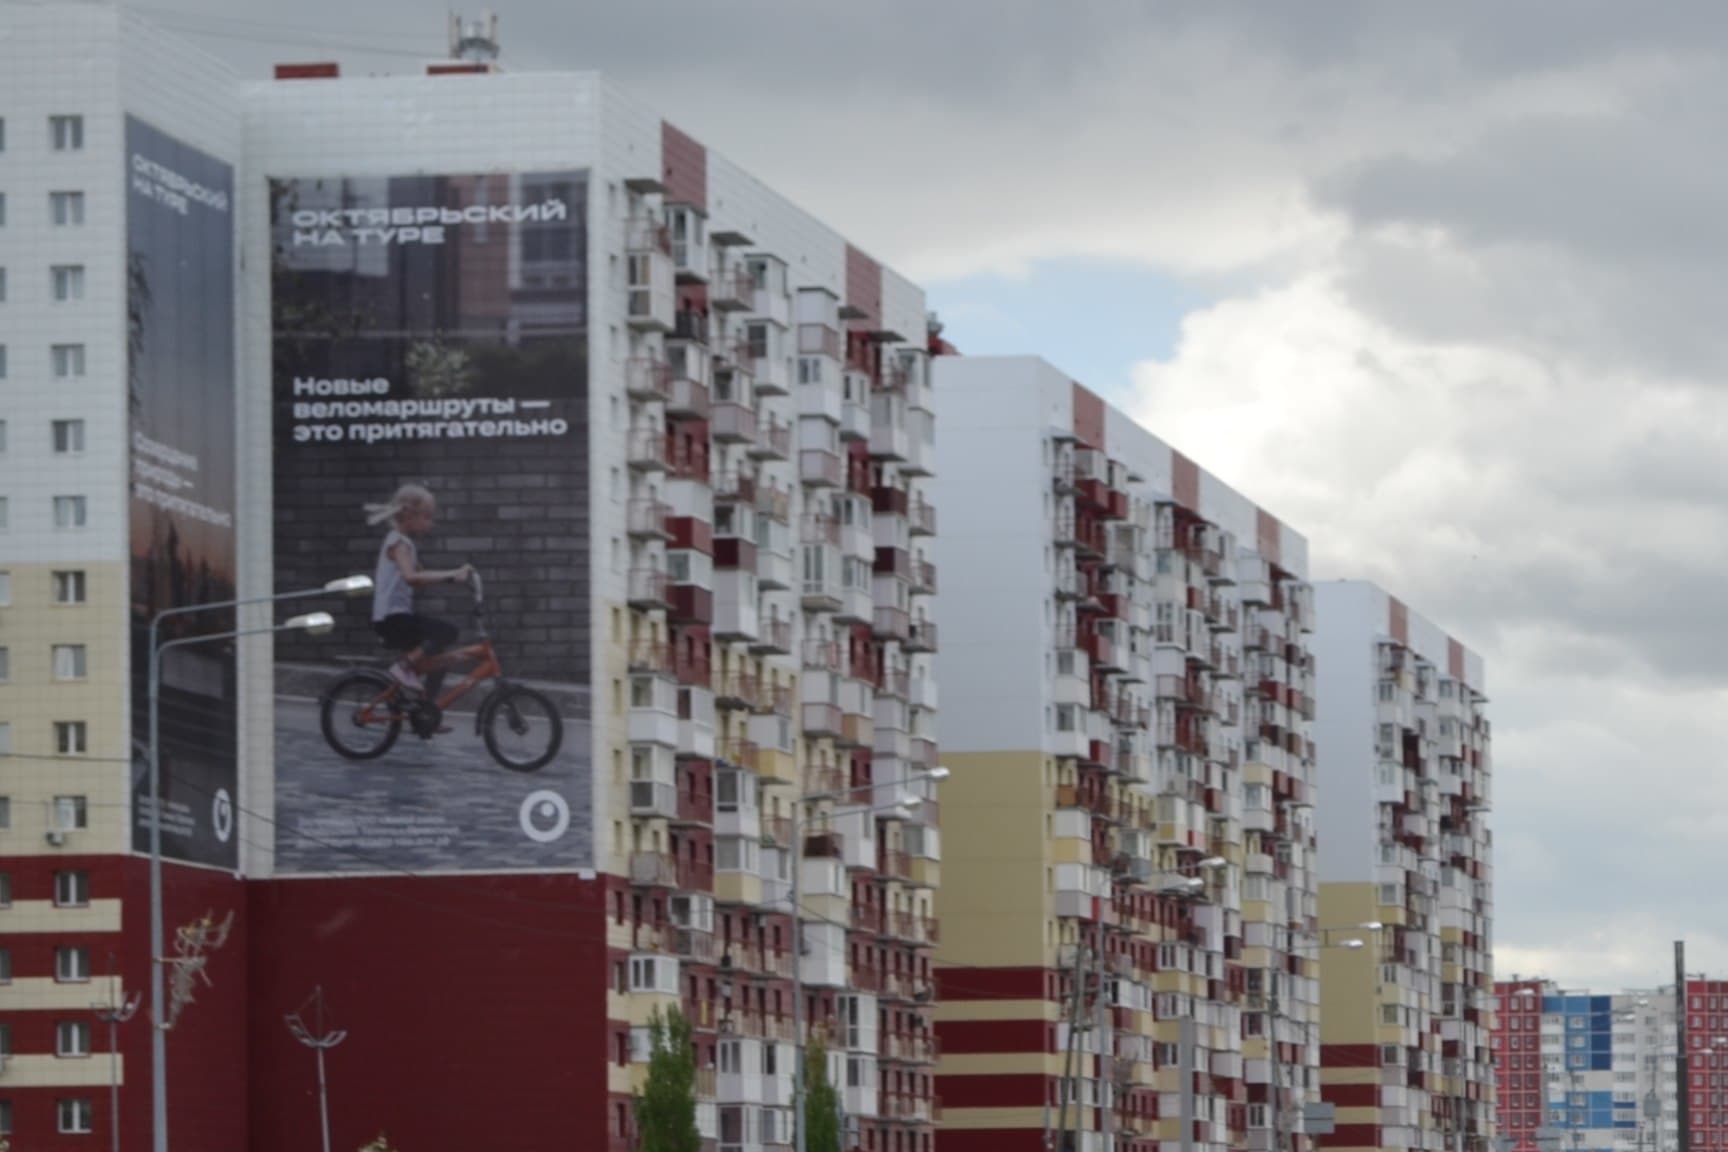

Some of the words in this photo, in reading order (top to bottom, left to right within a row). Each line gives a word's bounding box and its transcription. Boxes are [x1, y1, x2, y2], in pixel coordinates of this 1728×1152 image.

[292, 198, 567, 227] ОКТЯБРЬСКИЙ
[292, 227, 345, 246] НА
[352, 226, 445, 245] ТУРЕ
[293, 376, 390, 396] Новые
[293, 397, 515, 419] веломаршруты
[293, 422, 343, 441] это
[348, 418, 569, 443] притягательно
